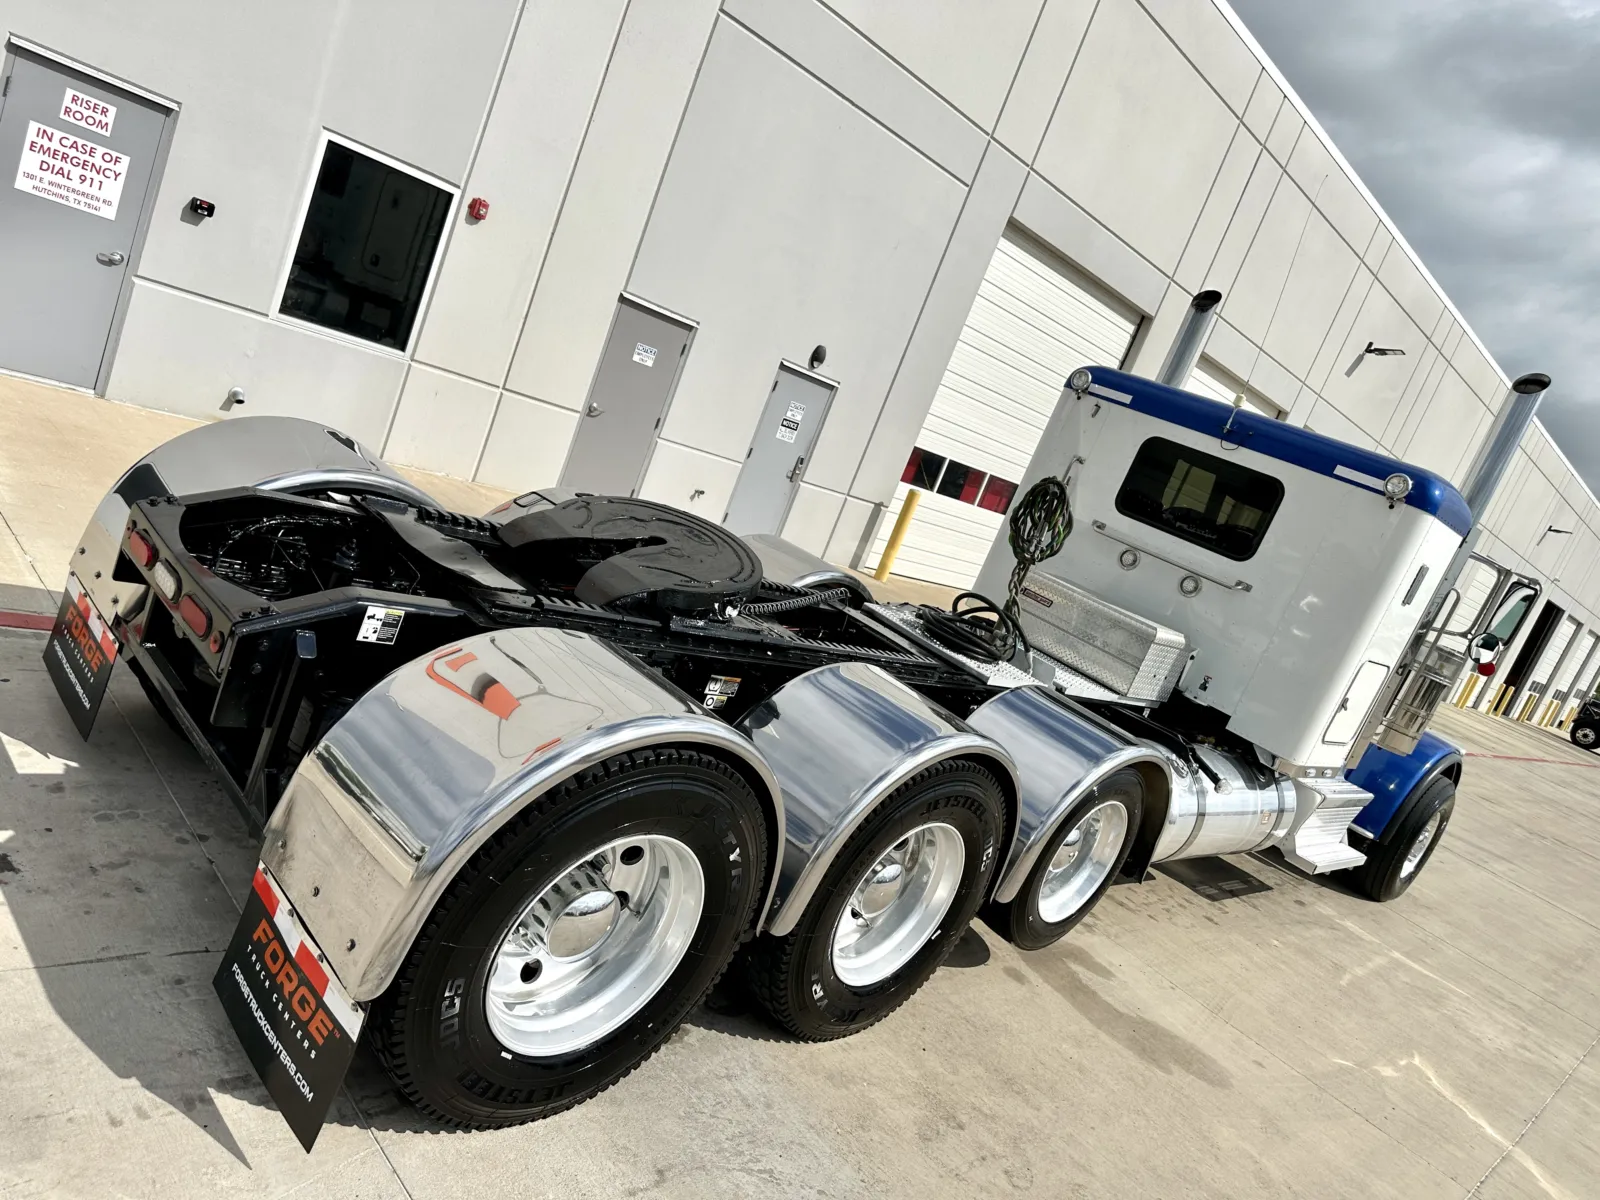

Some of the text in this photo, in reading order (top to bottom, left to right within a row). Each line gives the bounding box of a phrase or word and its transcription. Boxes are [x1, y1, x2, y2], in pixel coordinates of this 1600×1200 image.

[63, 106, 109, 132] ROOM
[71, 94, 109, 118] RISER
[29, 141, 122, 181] EMERGENCY
[36, 127, 122, 166] IN CASE OF
[22, 171, 38, 181] 1301
[48, 180, 100, 203] WINTERGREEN
[39, 160, 103, 191] DIAL 911
[32, 185, 101, 212] HUTCHINS, TX 75141
[65, 604, 103, 673] FORGE
[246, 943, 317, 1060] TRUCK CENTERS
[252, 918, 334, 1047] FORGE
[231, 962, 315, 1102] FORGETRUCKCENTERS.COM
